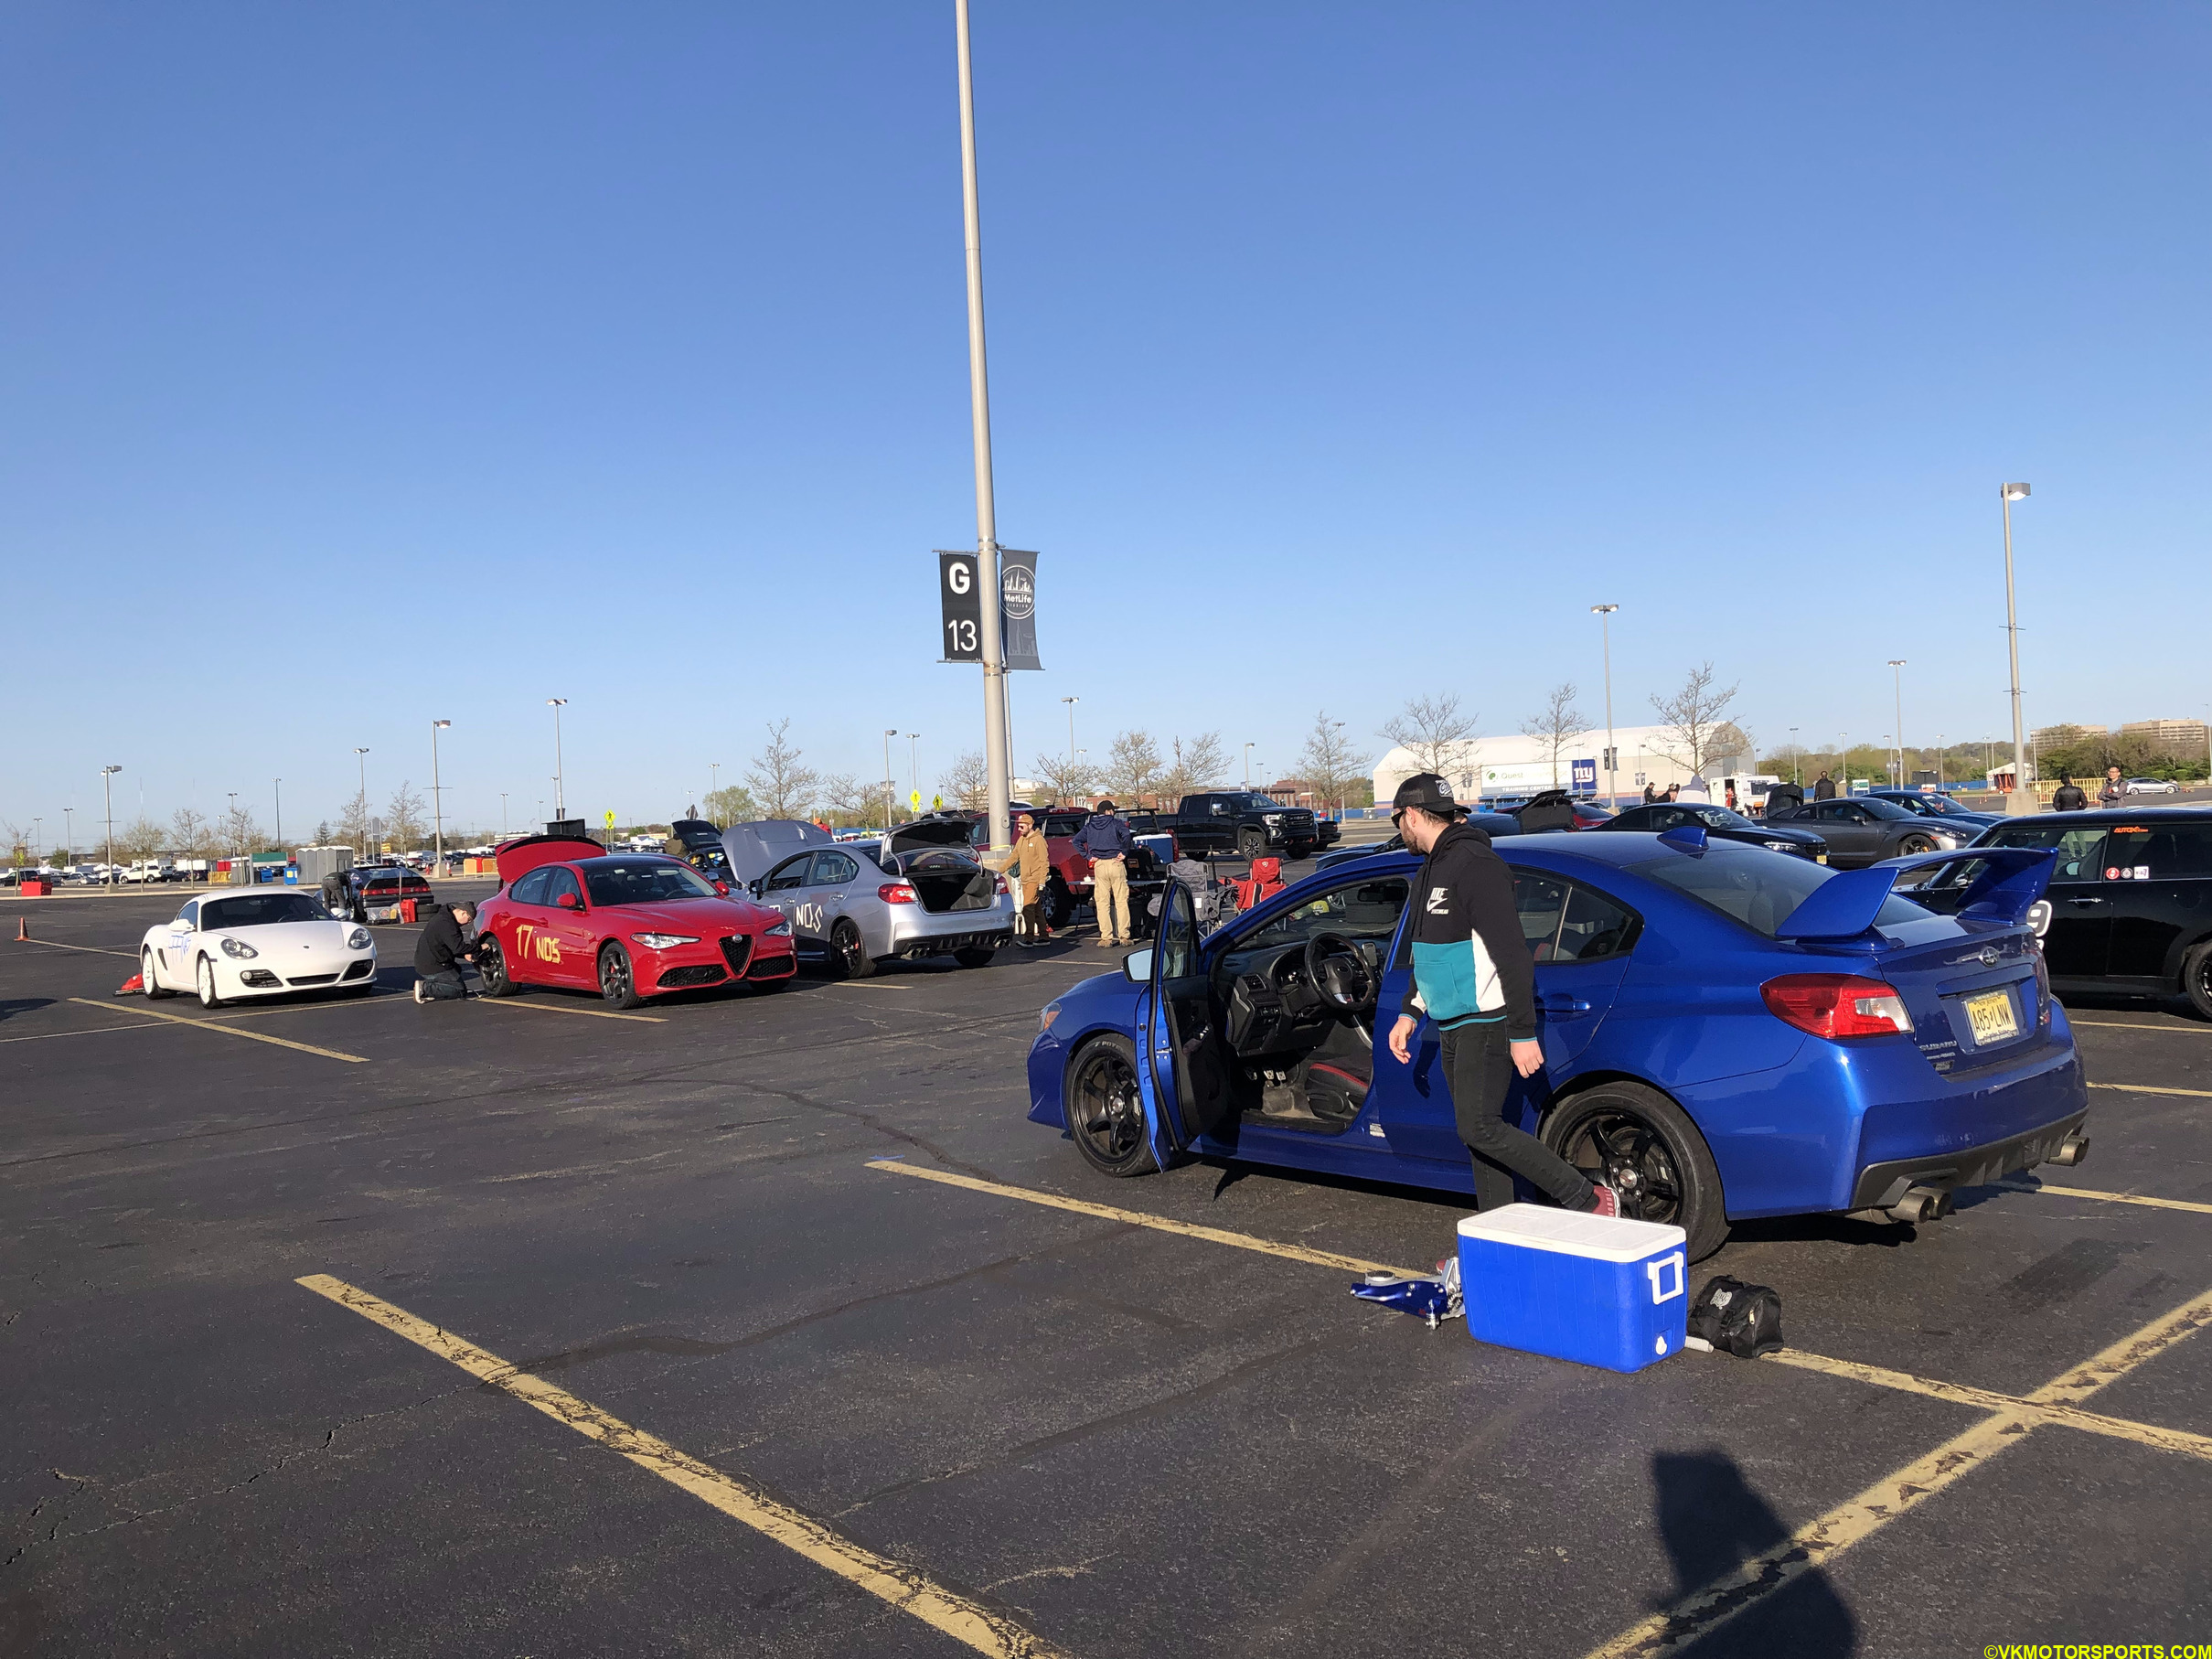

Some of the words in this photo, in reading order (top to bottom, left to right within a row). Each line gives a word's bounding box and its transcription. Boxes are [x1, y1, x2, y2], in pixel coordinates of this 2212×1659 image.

[949, 562, 970, 594] G
[1004, 594, 1031, 604] MetLife
[948, 619, 978, 652] 13
[1501, 772, 1523, 780] Quest
[1430, 887, 1448, 901] NIKE
[796, 903, 823, 933] NOS
[516, 924, 534, 960] 17
[536, 937, 561, 964] NOS
[1972, 1007, 1991, 1033] A85
[1918, 1040, 1958, 1052] SUBARU
